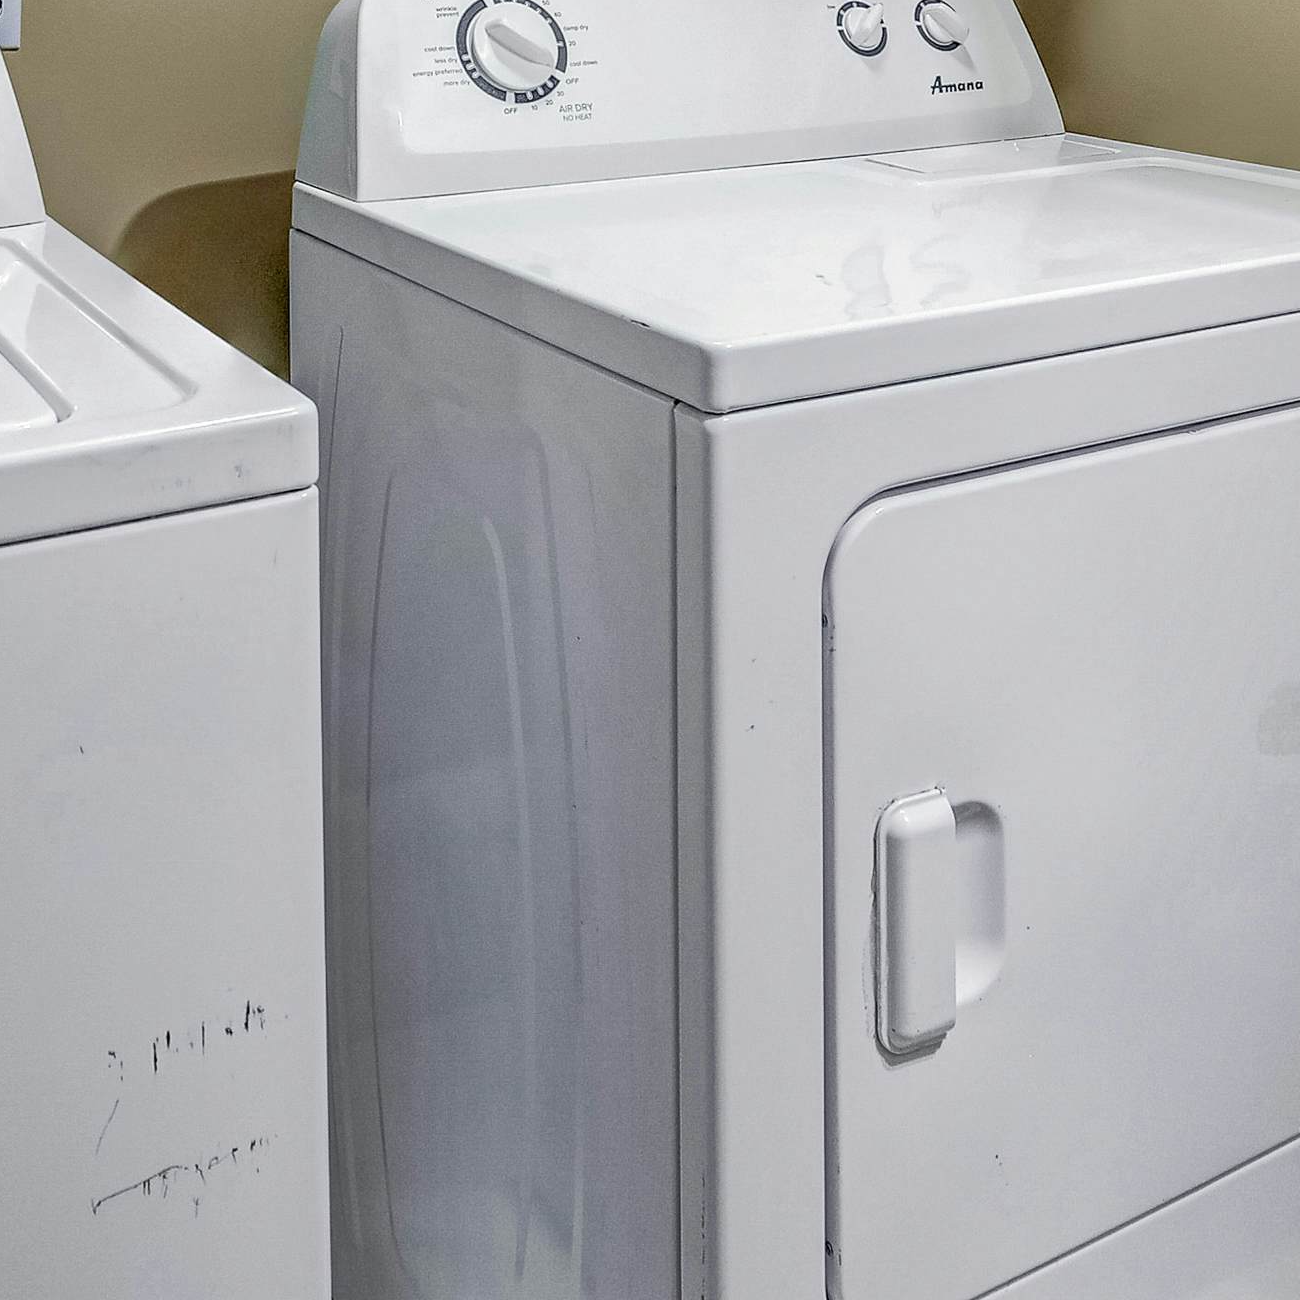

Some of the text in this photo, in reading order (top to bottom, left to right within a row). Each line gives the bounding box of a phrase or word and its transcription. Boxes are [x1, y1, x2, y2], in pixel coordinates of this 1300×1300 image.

[931, 76, 984, 95] Amana
[559, 103, 593, 113] AIR DRY
